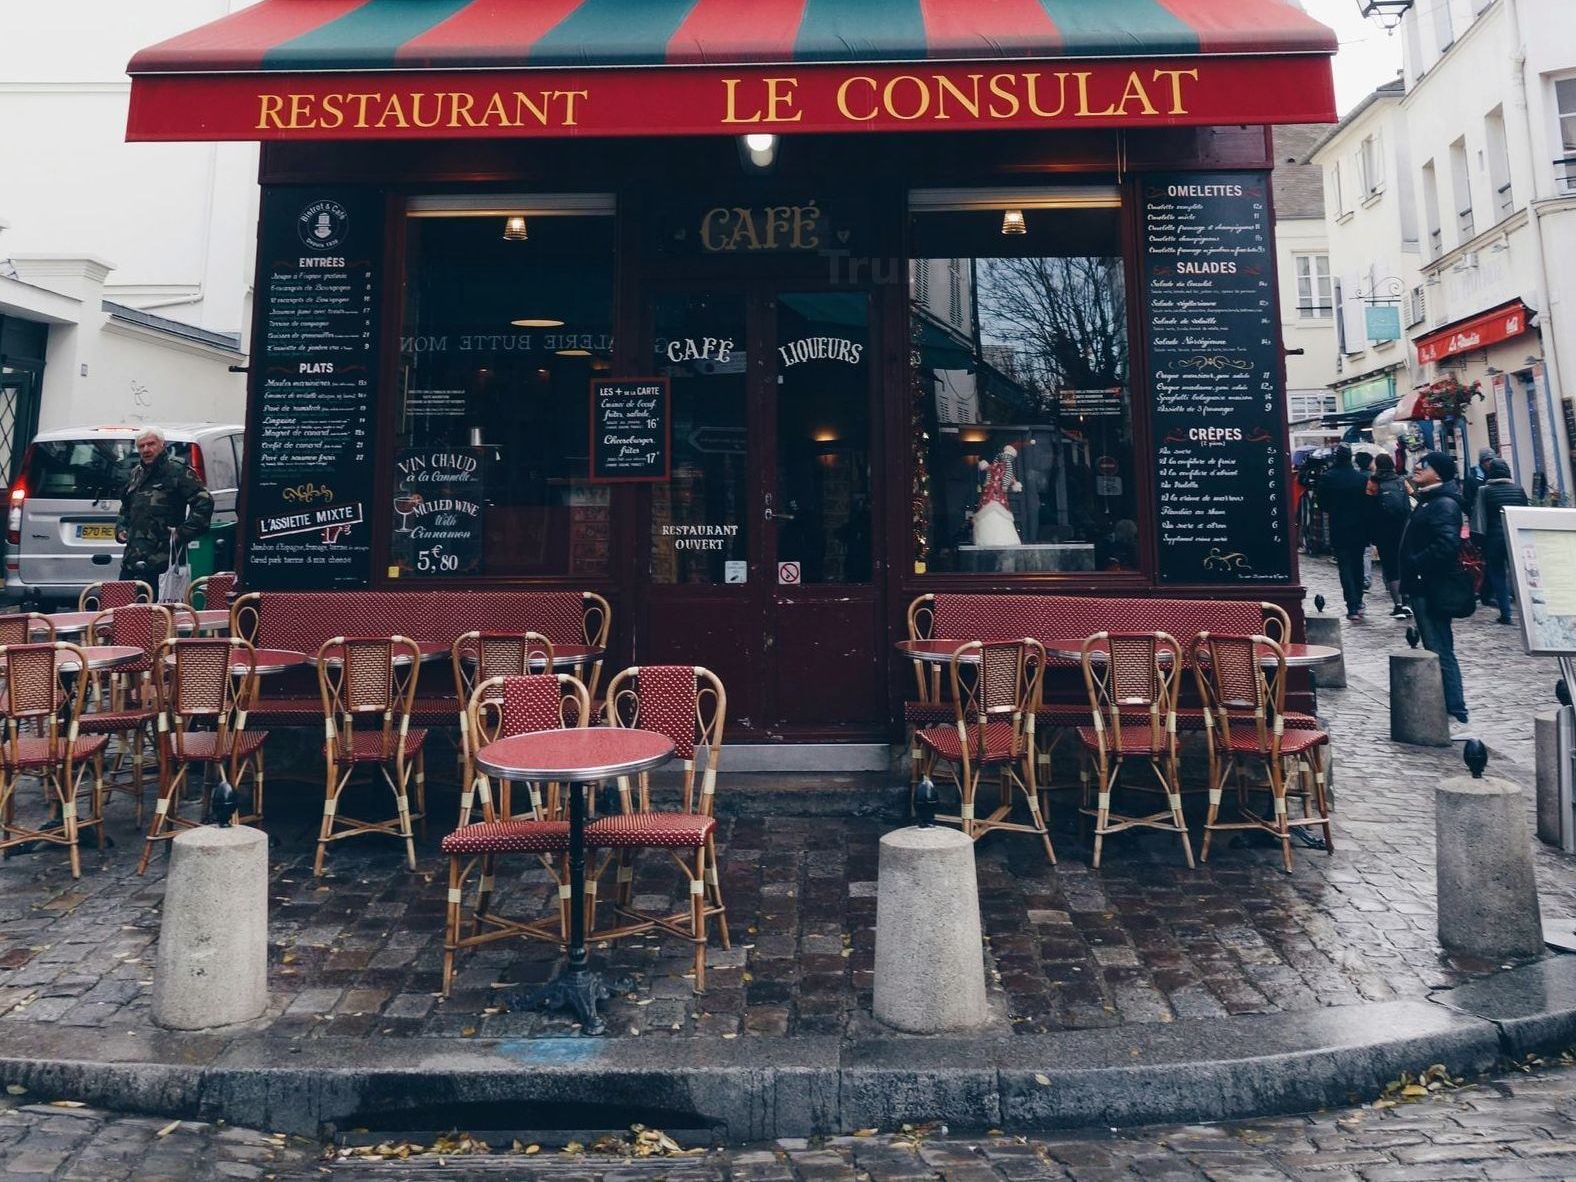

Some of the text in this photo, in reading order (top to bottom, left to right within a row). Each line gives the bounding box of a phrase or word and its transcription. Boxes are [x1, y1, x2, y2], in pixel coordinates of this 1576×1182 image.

[256, 69, 1199, 130] RESTAURANT LE CONSULAT
[1168, 185, 1242, 196] OMELETTES
[299, 256, 345, 268] ENTRÉES
[1177, 261, 1237, 274] SALADES
[1150, 279, 1173, 287] Salade
[1152, 317, 1177, 325] Salade
[1153, 337, 1178, 345] Salade
[778, 337, 863, 367] LIQUEURS
[299, 363, 334, 374] PLATS
[600, 388, 613, 396] LES
[637, 387, 660, 396] CARTE
[1265, 403, 1272, 412] 9
[1189, 426, 1242, 441] CRÊPES
[398, 453, 477, 473] VIN CHAUD
[1268, 457, 1274, 465] 6
[418, 471, 429, 481] la
[413, 499, 479, 517] MULLED WINE
[260, 506, 353, 533] L'ASSIETTE MIXTE
[1272, 521, 1278, 529] 6
[410, 526, 470, 539] Cinnamon
[662, 525, 738, 536] RESTAURANT
[675, 539, 724, 550] OUVERT
